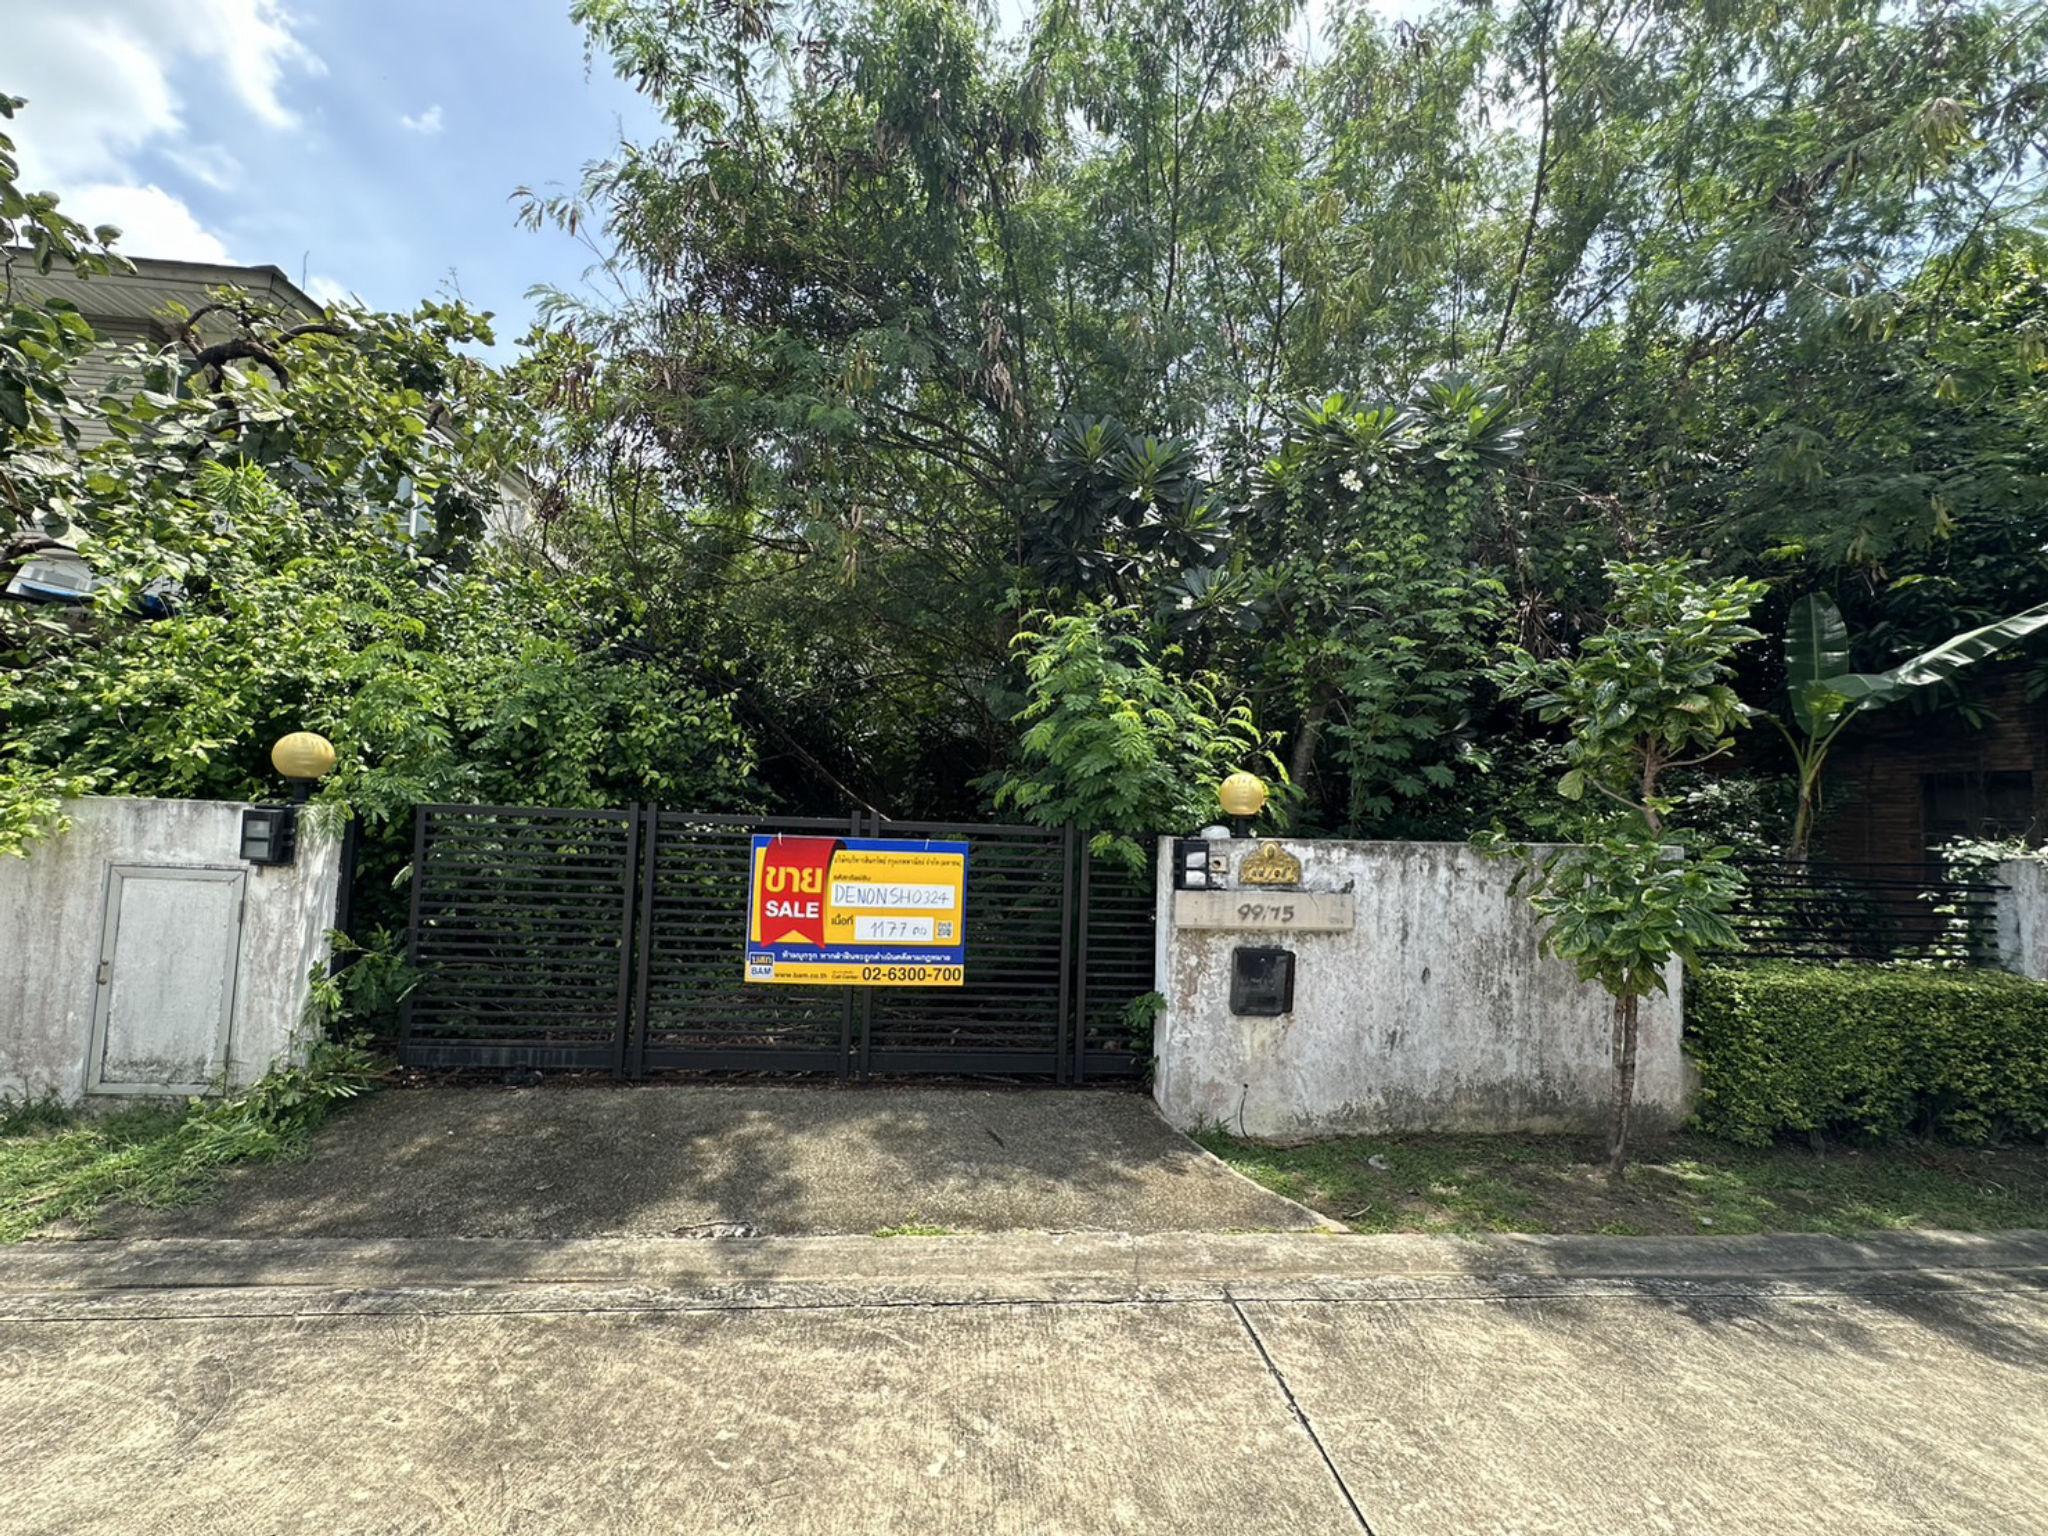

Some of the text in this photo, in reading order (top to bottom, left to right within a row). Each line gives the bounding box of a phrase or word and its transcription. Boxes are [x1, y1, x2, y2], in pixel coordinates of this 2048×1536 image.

[765, 866, 823, 894] ขาย
[765, 900, 820, 918] SALE
[751, 967, 771, 975] BAM
[862, 966, 962, 982] 02-6300-700
